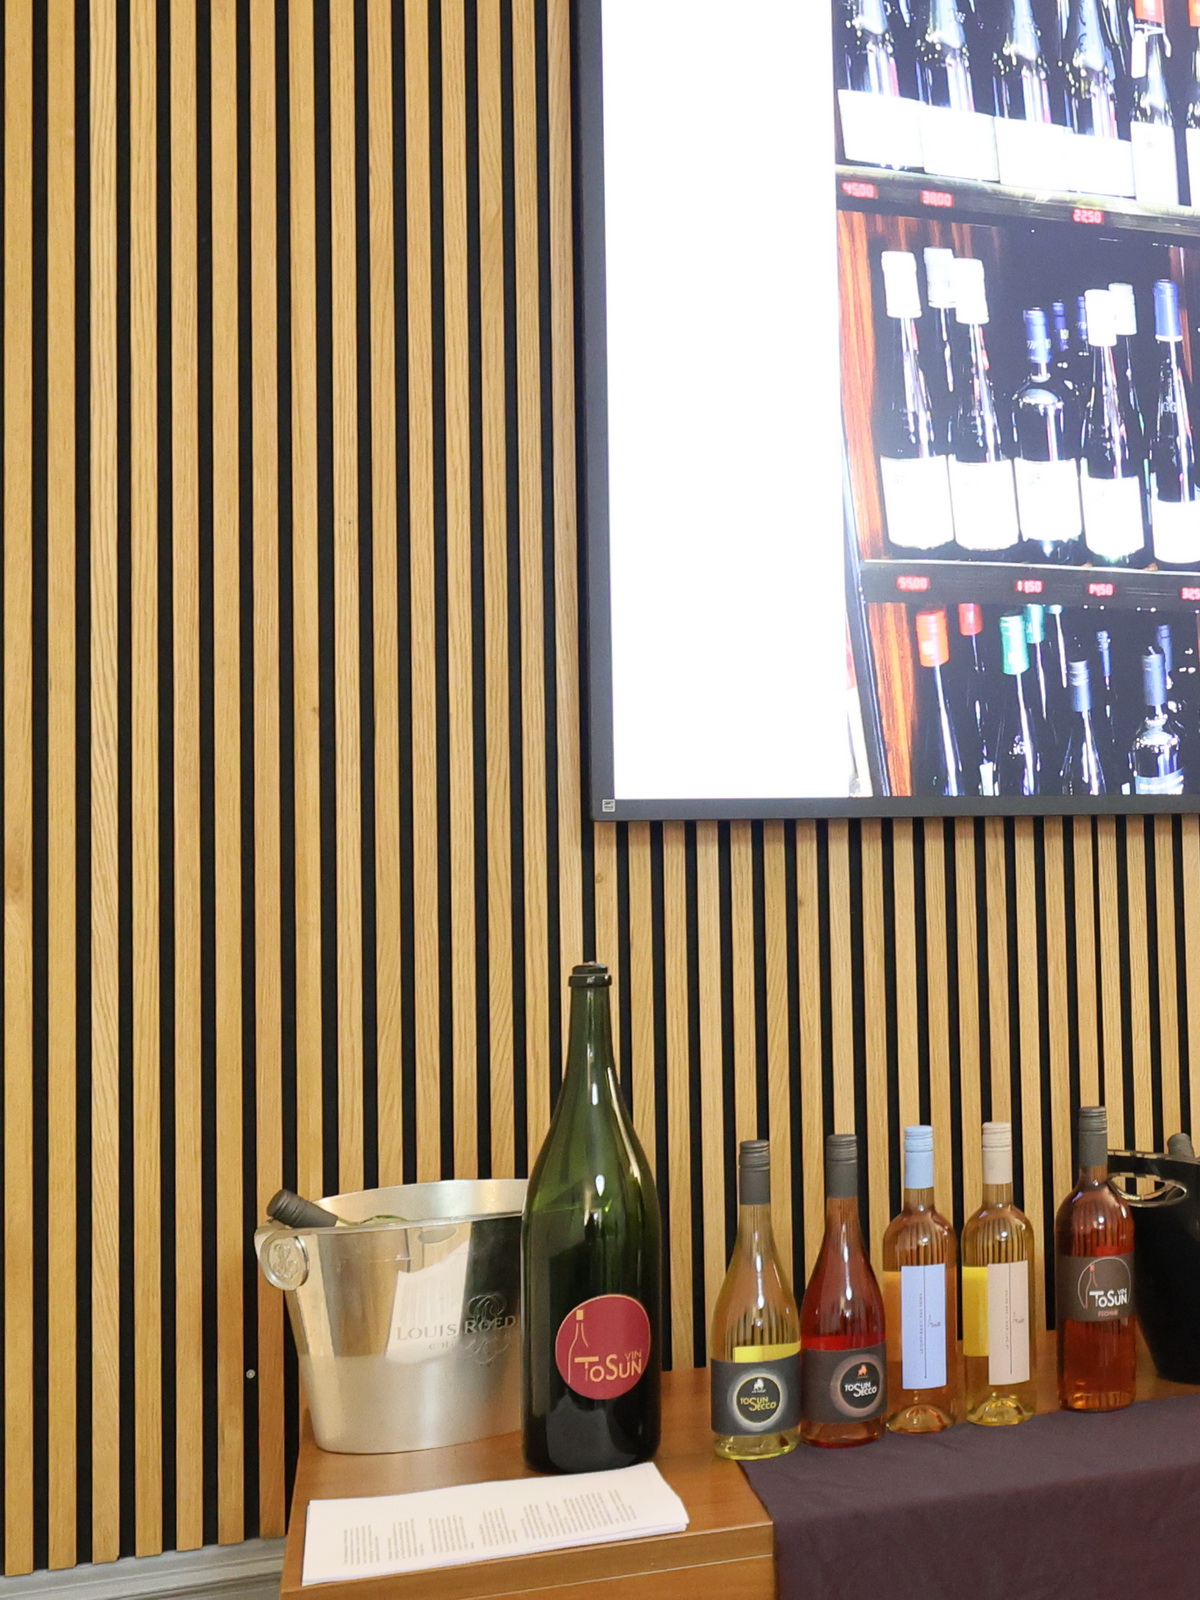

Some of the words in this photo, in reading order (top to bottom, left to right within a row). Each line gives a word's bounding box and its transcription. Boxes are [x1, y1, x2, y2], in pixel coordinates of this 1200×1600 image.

[396, 1323, 457, 1342] LOUIS
[464, 1315, 516, 1335] ROED
[624, 1349, 643, 1361] VIN
